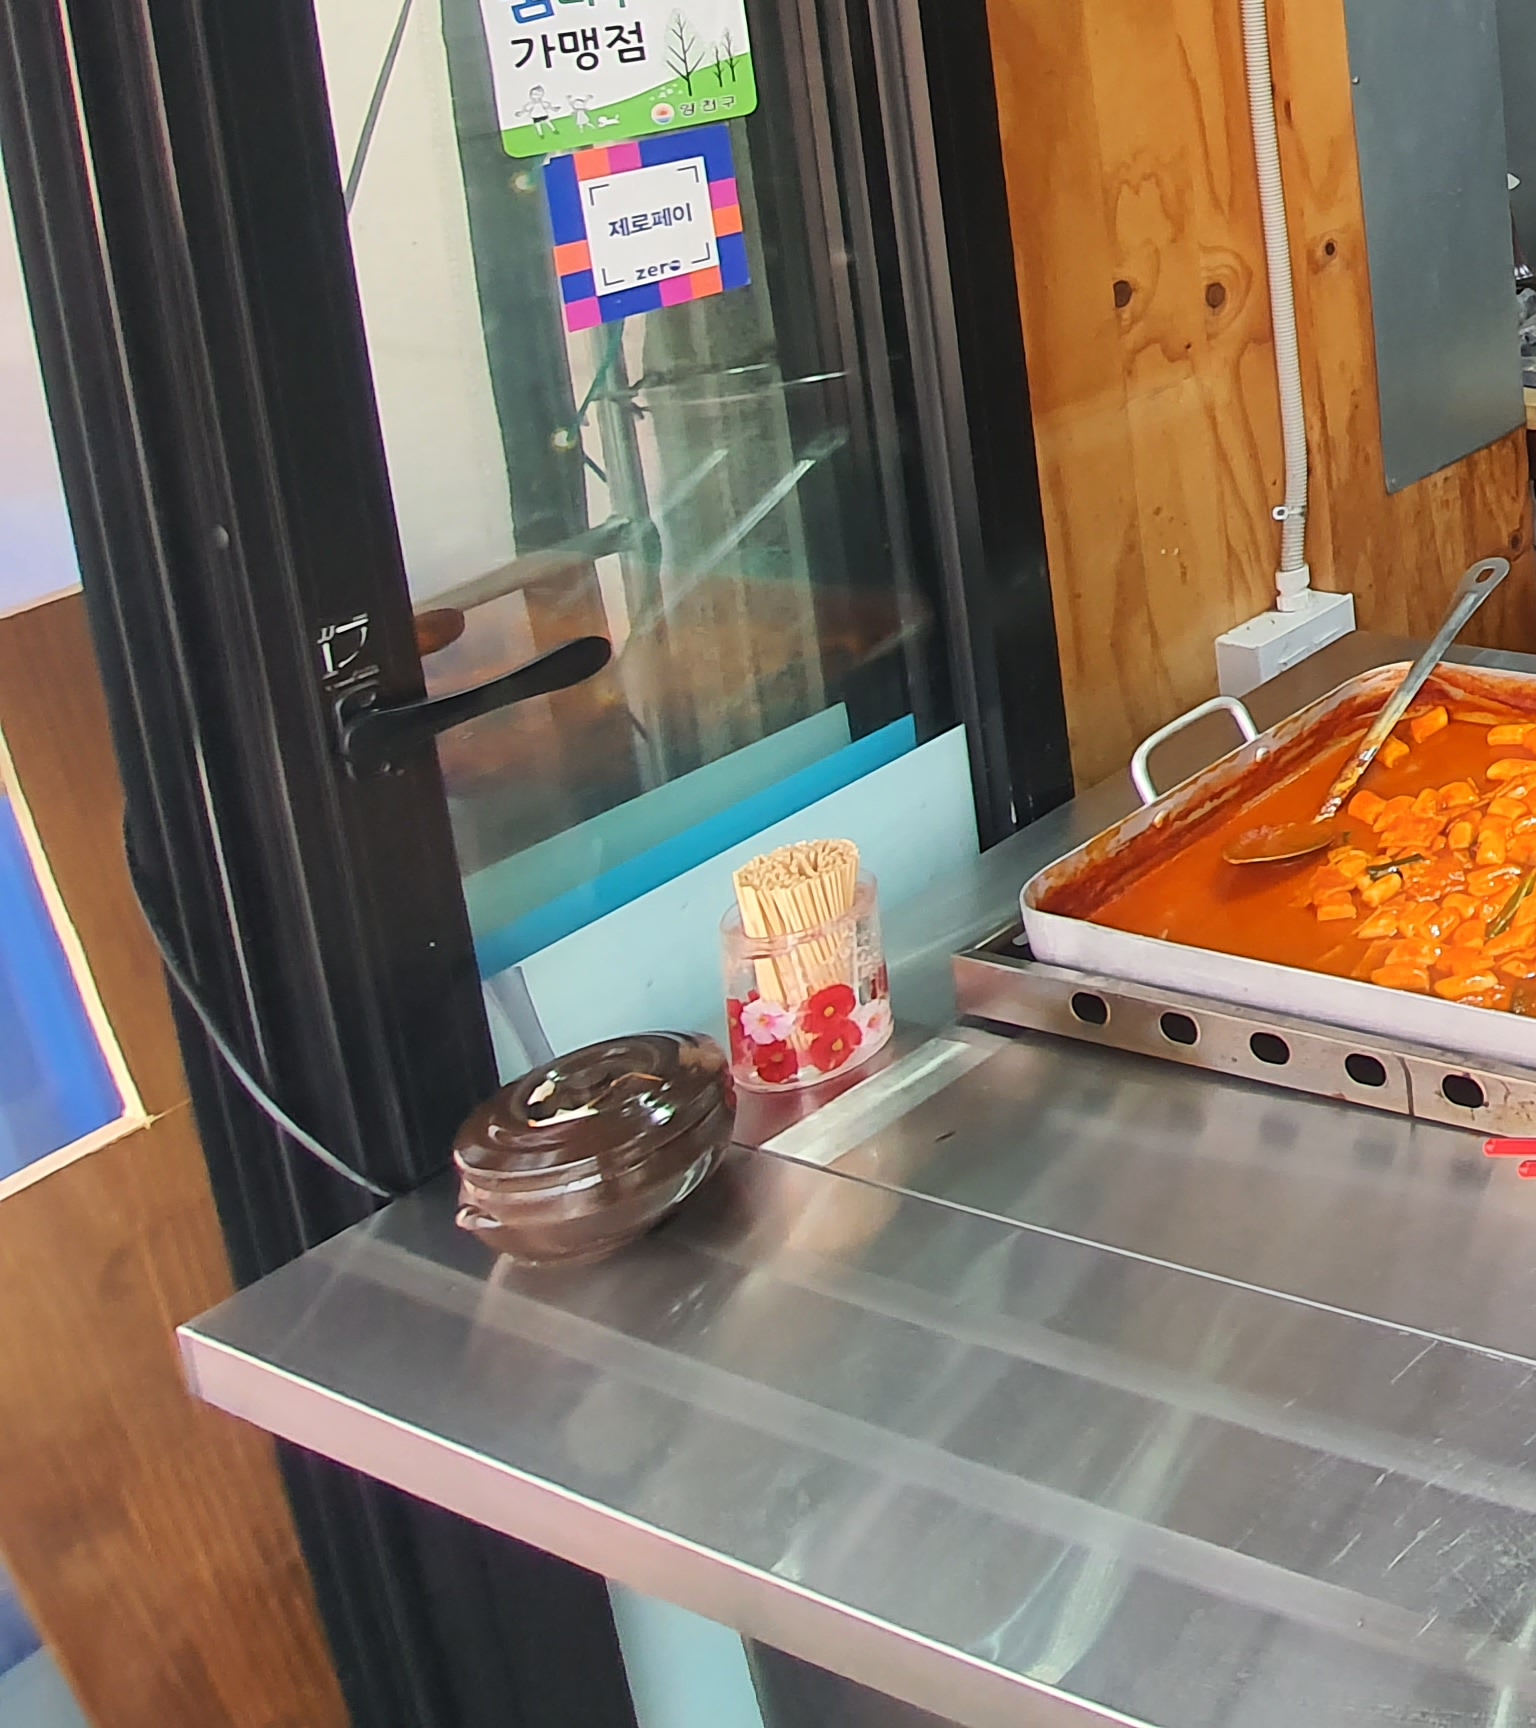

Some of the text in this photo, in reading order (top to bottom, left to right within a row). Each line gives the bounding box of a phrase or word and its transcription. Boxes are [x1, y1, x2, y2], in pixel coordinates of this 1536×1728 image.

[510, 21, 647, 71] 가맹점
[608, 202, 693, 240] 제로페이
[633, 258, 682, 282] zero
